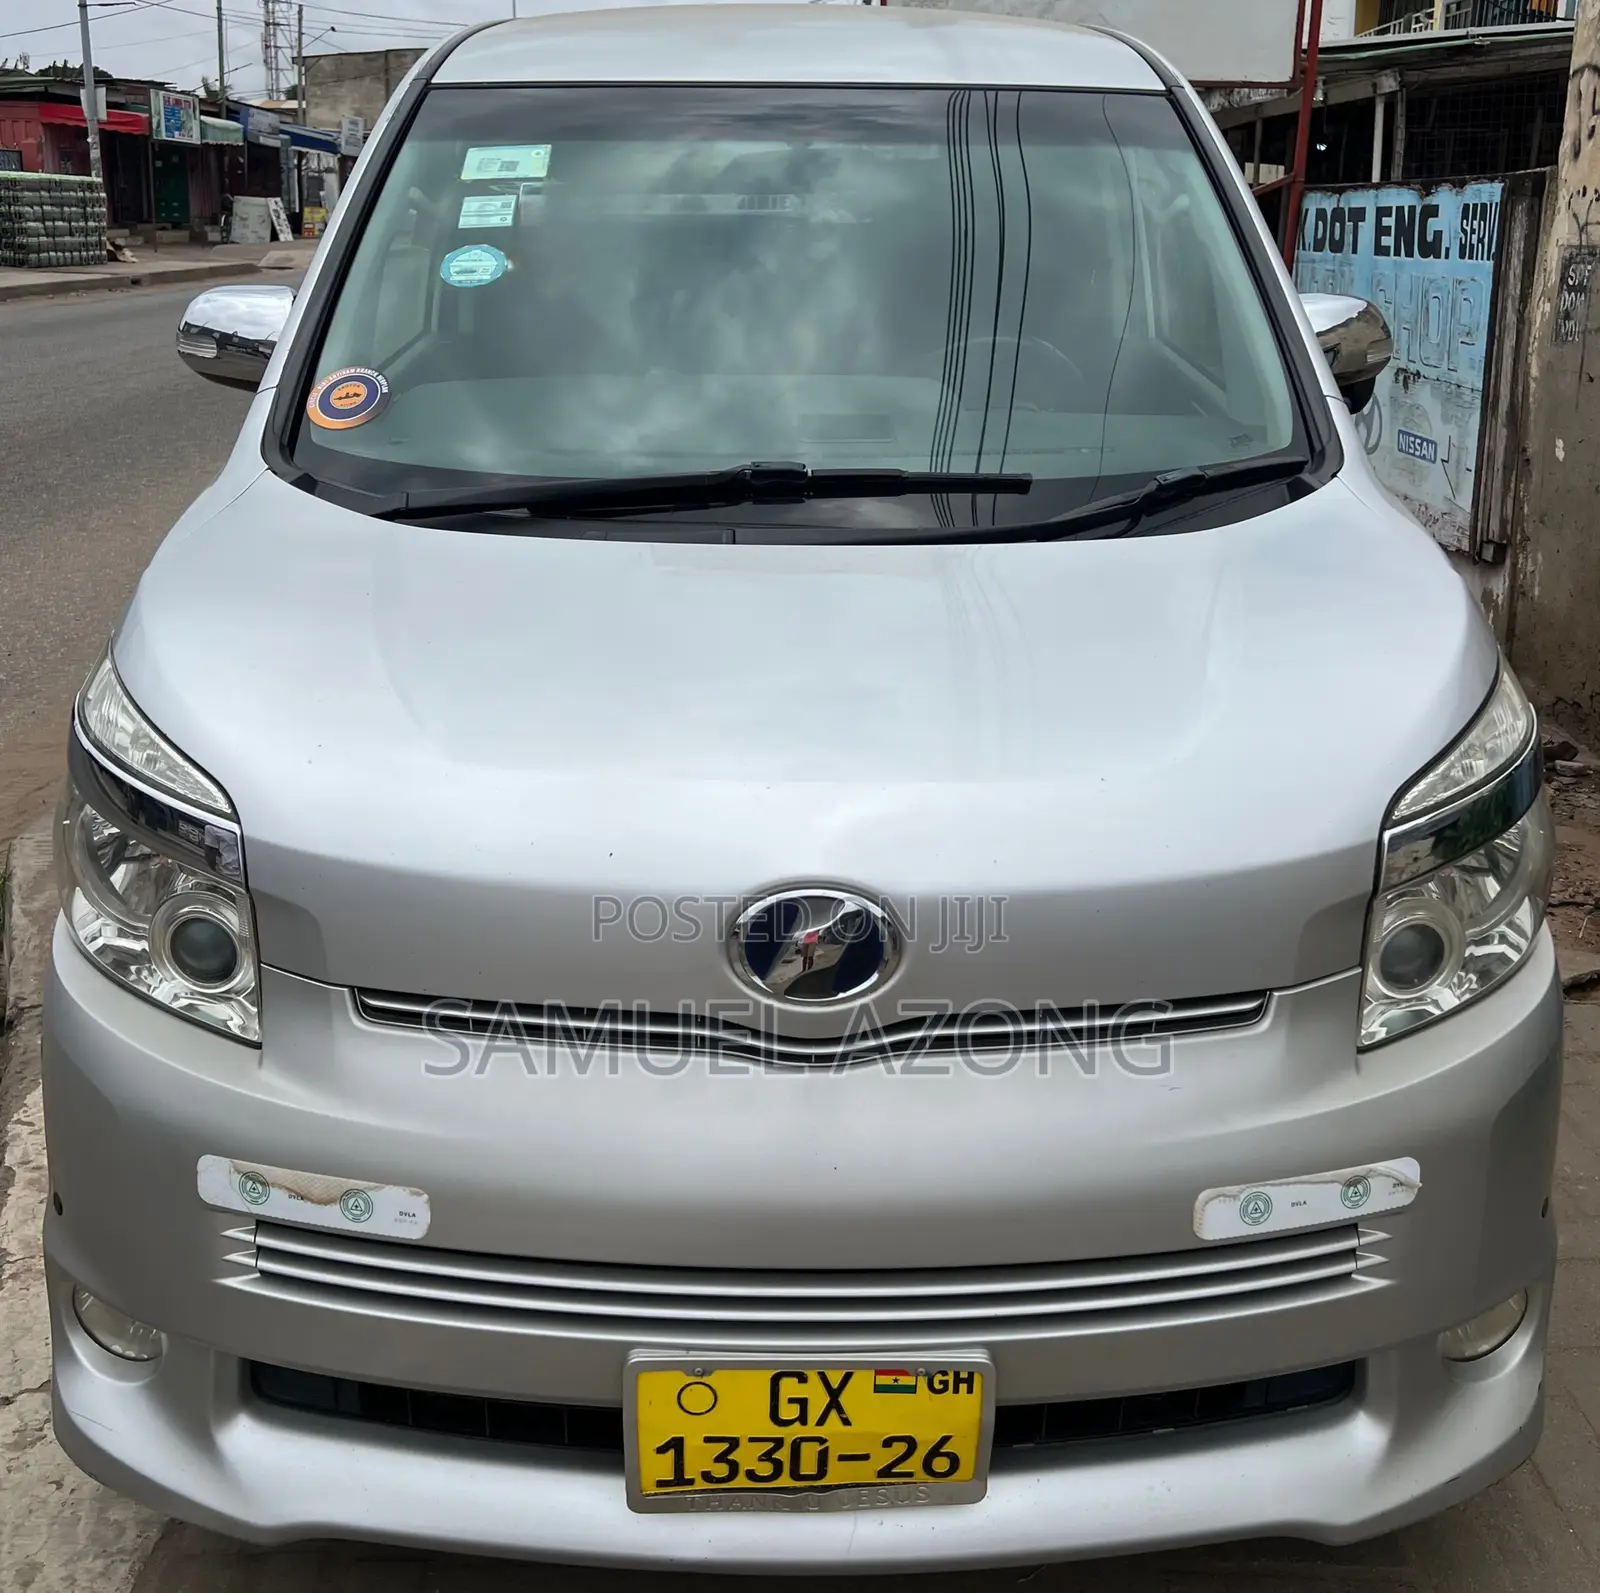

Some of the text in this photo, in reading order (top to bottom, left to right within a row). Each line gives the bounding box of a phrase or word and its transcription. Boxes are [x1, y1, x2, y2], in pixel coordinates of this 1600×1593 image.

[1374, 204, 1449, 259] ENG.
[1398, 433, 1436, 462] NISSAN
[1290, 1200, 1308, 1208] DVLA
[927, 1370, 974, 1395] GH
[769, 1370, 854, 1427] GX
[655, 1434, 960, 1488] 1330-26
[841, 1486, 930, 1508] JESUS
